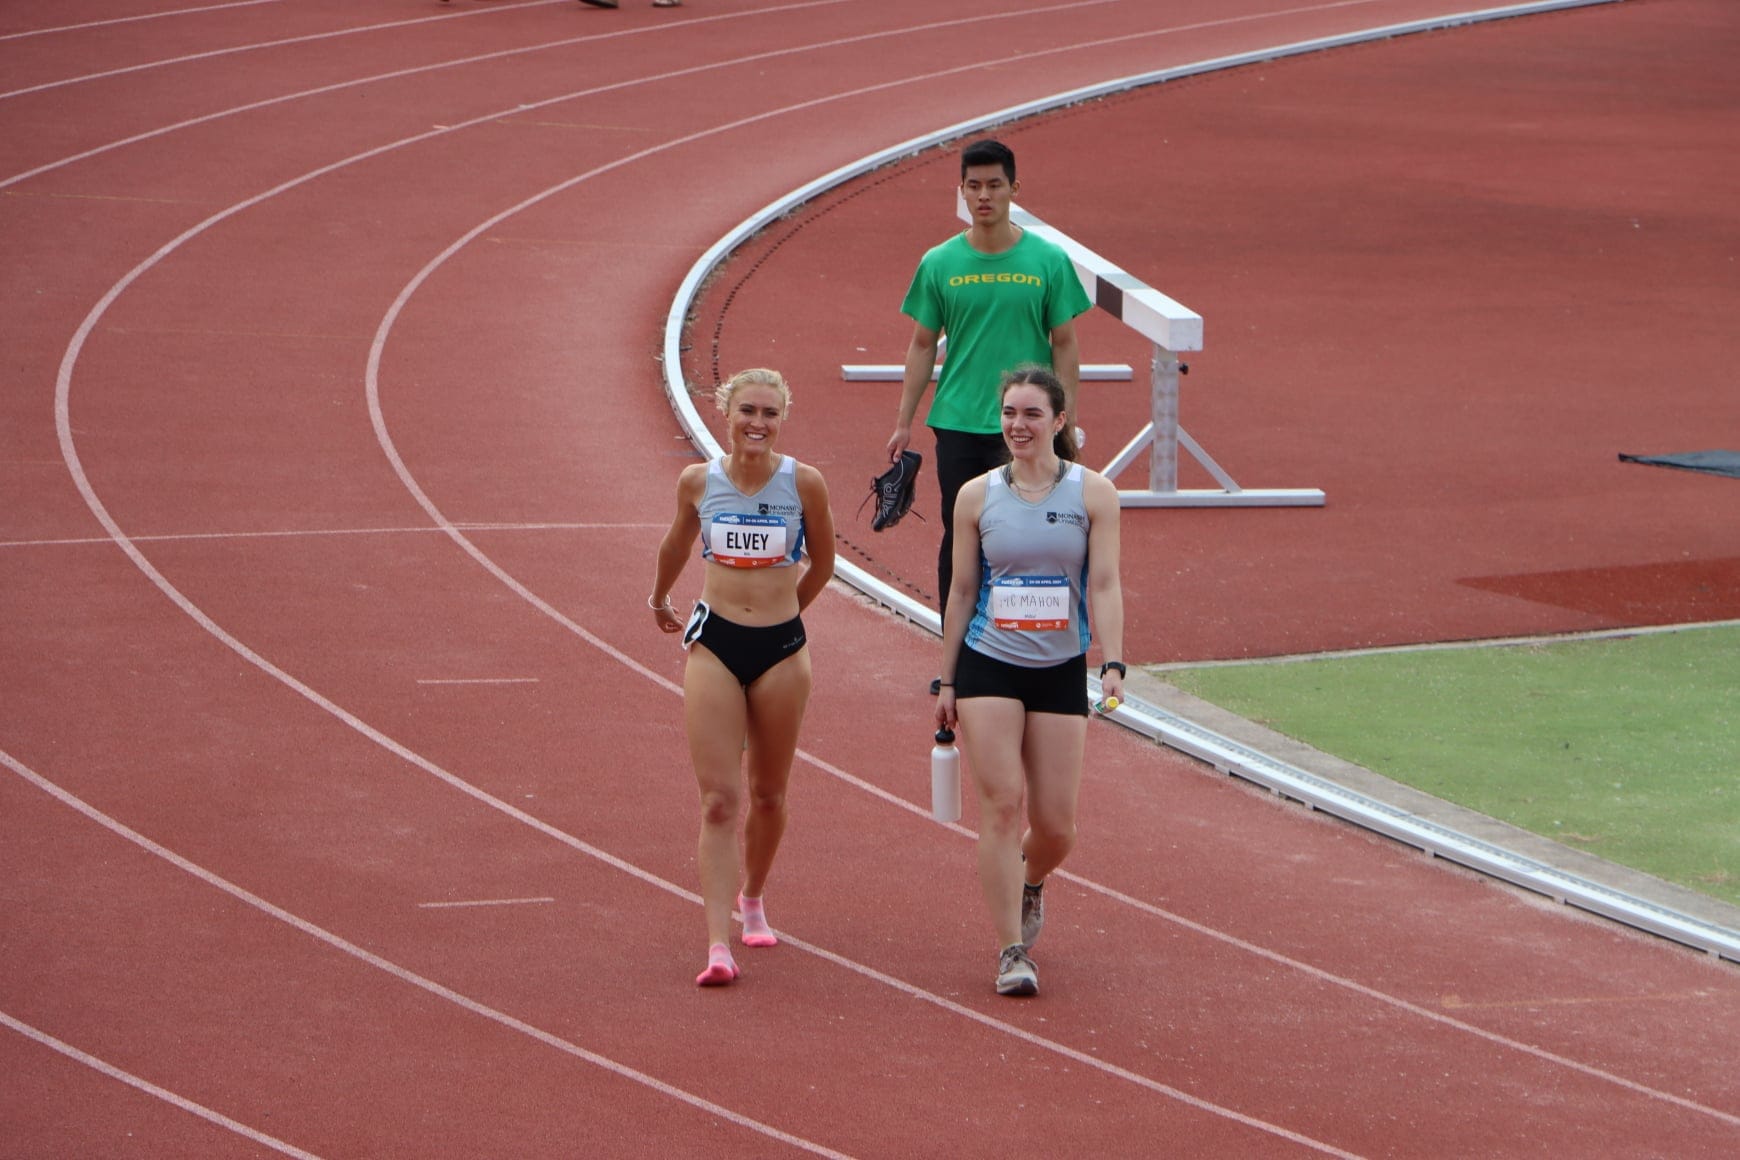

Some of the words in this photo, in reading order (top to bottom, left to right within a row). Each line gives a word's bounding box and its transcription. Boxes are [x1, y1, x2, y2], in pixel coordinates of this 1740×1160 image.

[949, 273, 1041, 287] OREGON
[726, 531, 769, 551] ELVEY
[1020, 594, 1060, 608] MAHON
